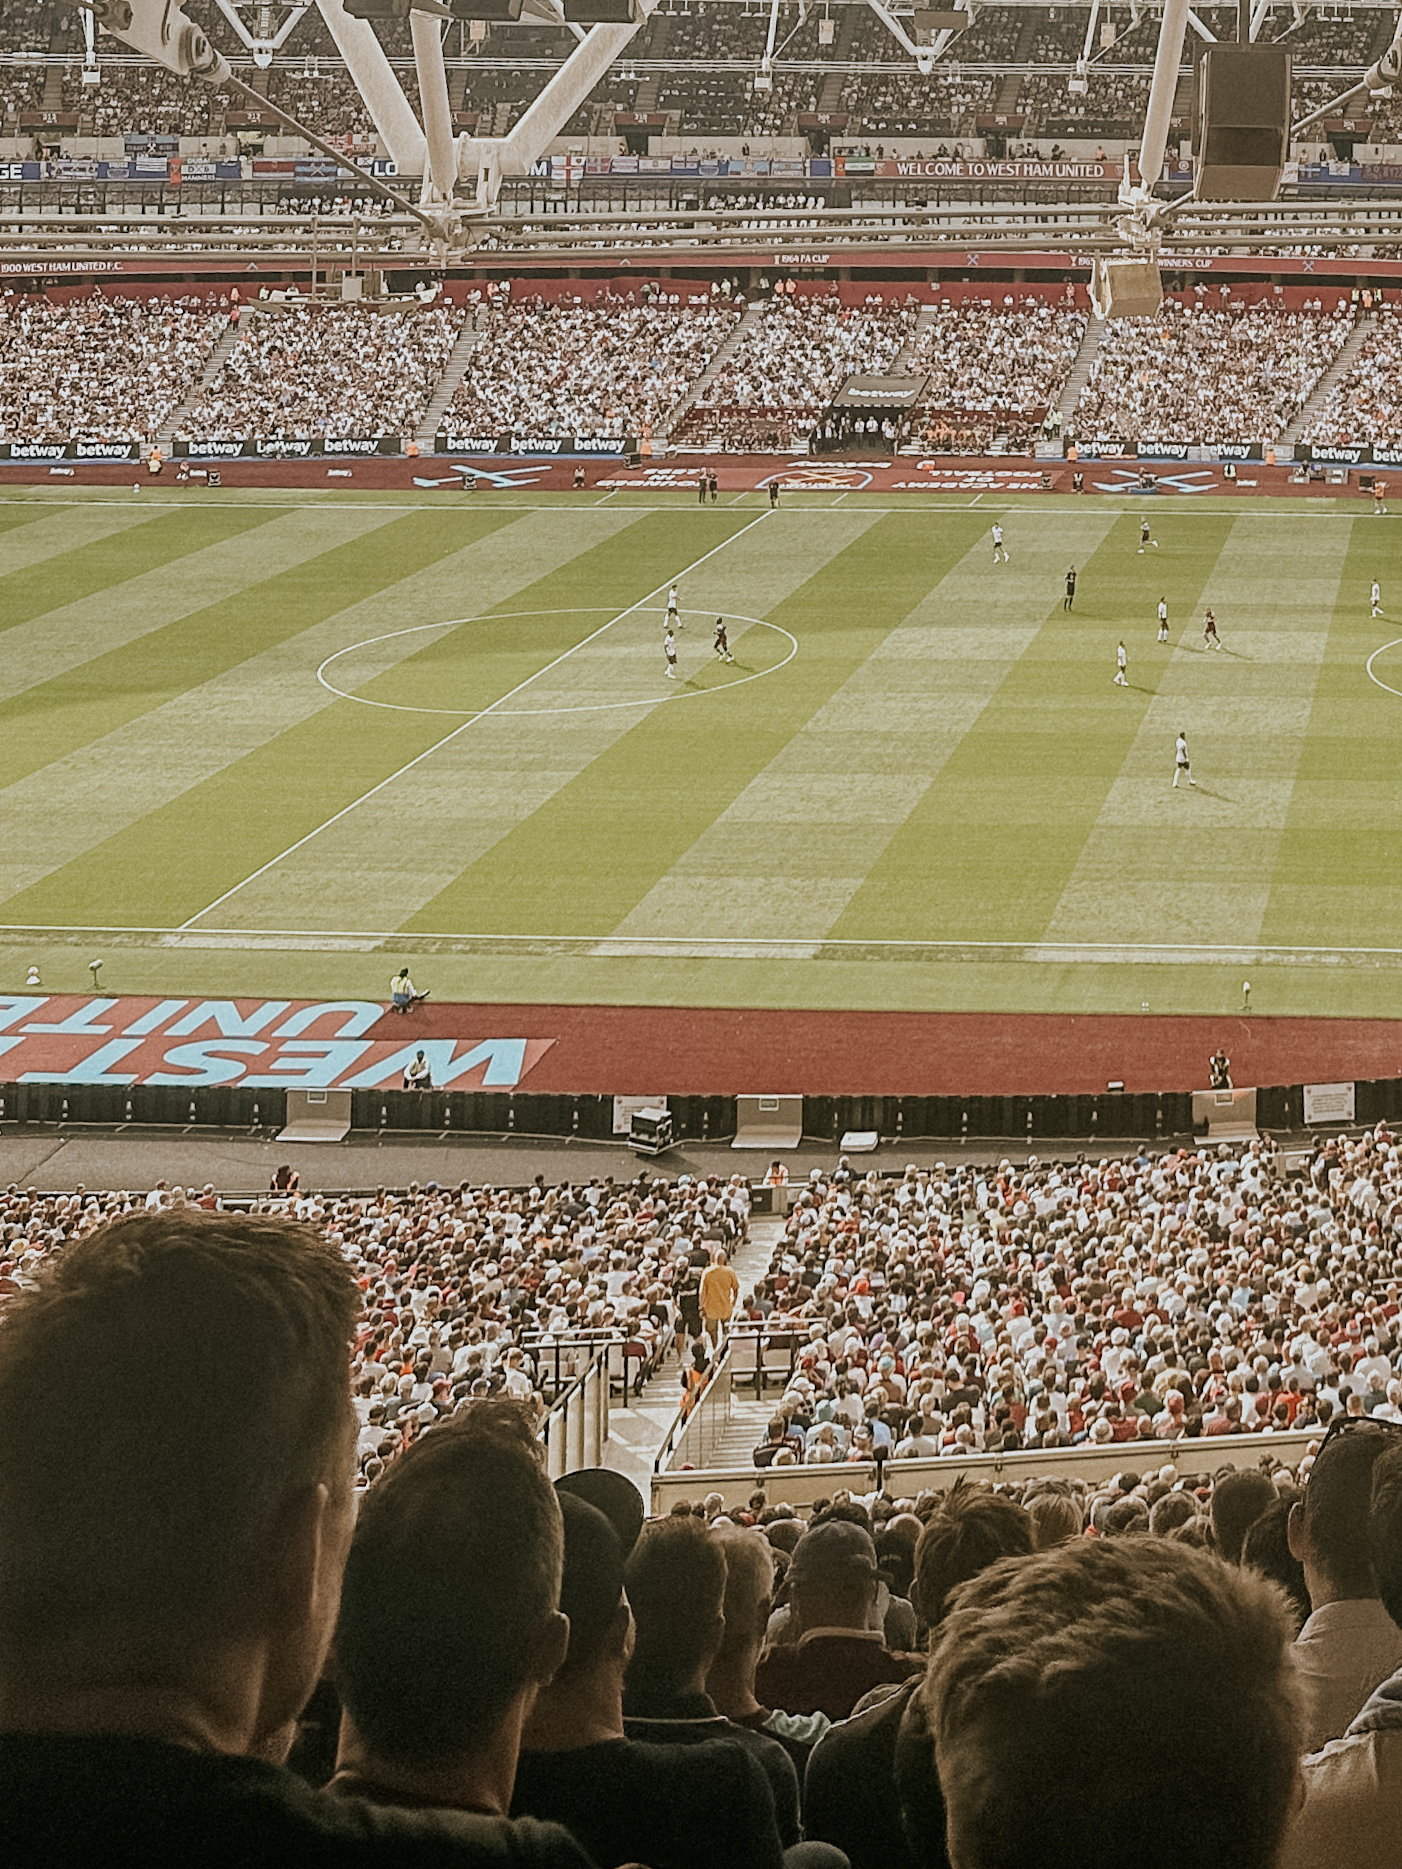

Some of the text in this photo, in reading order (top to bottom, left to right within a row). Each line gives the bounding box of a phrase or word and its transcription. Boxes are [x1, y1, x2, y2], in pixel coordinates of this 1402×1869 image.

[897, 162, 1104, 178] WELCOME TO WEST HAM UNITED
[23, 263, 48, 273] WEST
[49, 262, 71, 272] HAM
[71, 262, 106, 272] UNITED
[1195, 259, 1213, 268] CUP
[847, 387, 916, 399] betway
[10, 443, 66, 459] betway
[76, 442, 133, 458] betway
[188, 440, 244, 457] betway
[256, 439, 312, 456] betway
[324, 438, 379, 455] betway
[446, 437, 498, 454] betway
[510, 437, 562, 454] betway
[573, 437, 626, 454] betway
[1075, 440, 1126, 456] betway
[1137, 441, 1188, 459] betway
[1311, 446, 1361, 464] betway
[928, 470, 1043, 478] FOOTBALL
[890, 481, 1005, 489] ACADEMY
[16, 1038, 528, 1088] WEST
